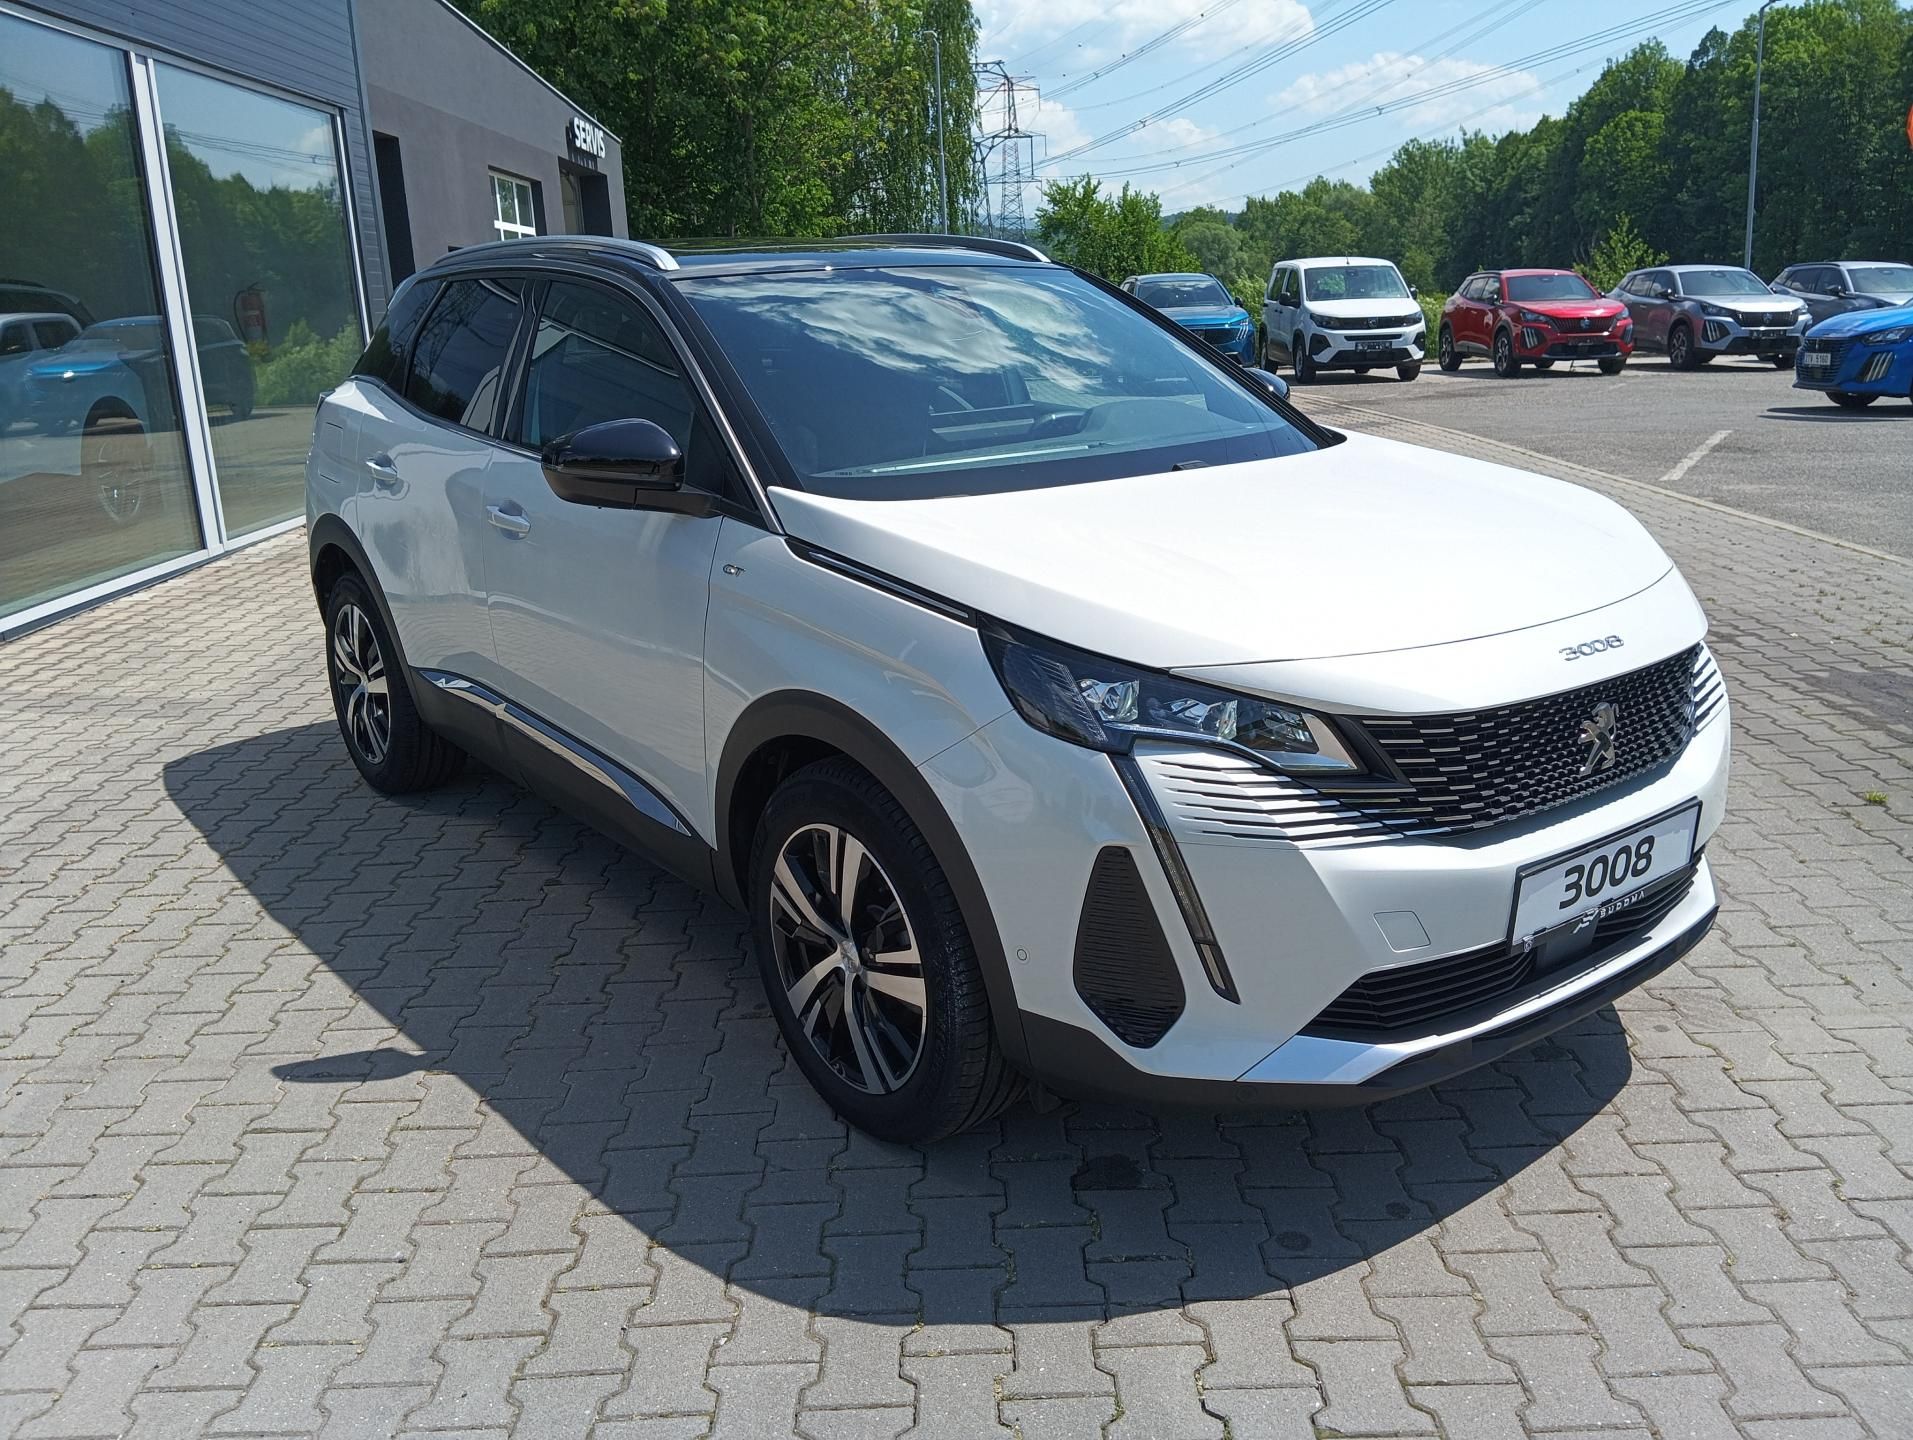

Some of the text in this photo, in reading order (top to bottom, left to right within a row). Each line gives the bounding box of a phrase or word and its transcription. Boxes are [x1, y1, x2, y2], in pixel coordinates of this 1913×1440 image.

[573, 117, 606, 159] SERVIS
[1558, 634, 1625, 661] 3008
[1558, 835, 1656, 910] 3008
